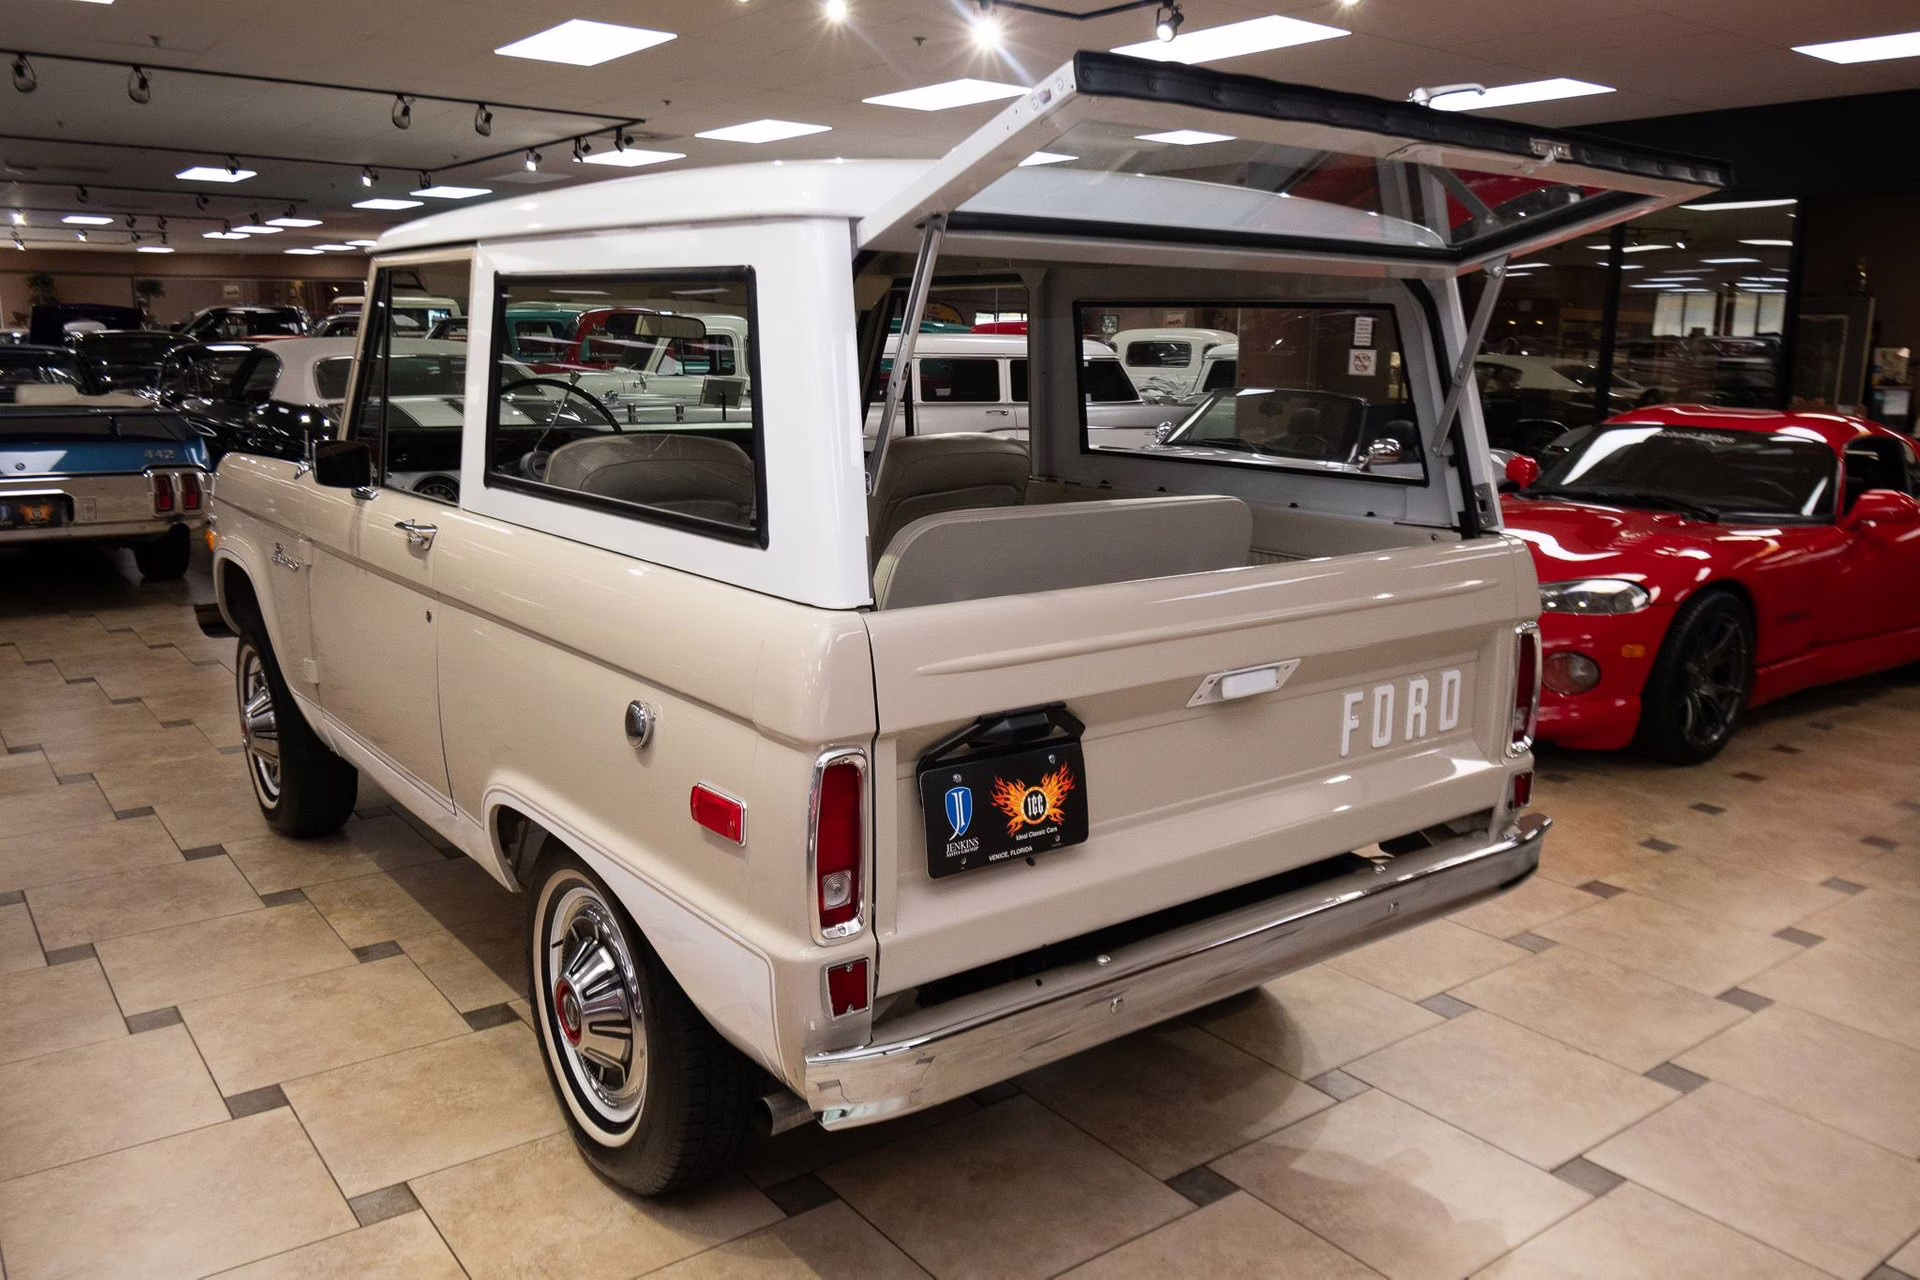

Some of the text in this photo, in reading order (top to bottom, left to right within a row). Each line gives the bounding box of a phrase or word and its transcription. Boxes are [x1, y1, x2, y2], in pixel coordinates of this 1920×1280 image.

[143, 449, 177, 459] 442
[1340, 669, 1461, 757] FORD
[1016, 832, 1028, 841] Ideal
[1028, 828, 1045, 838] Classic
[946, 837, 979, 854] JENKINS
[1011, 846, 1032, 856] FLORIDA
